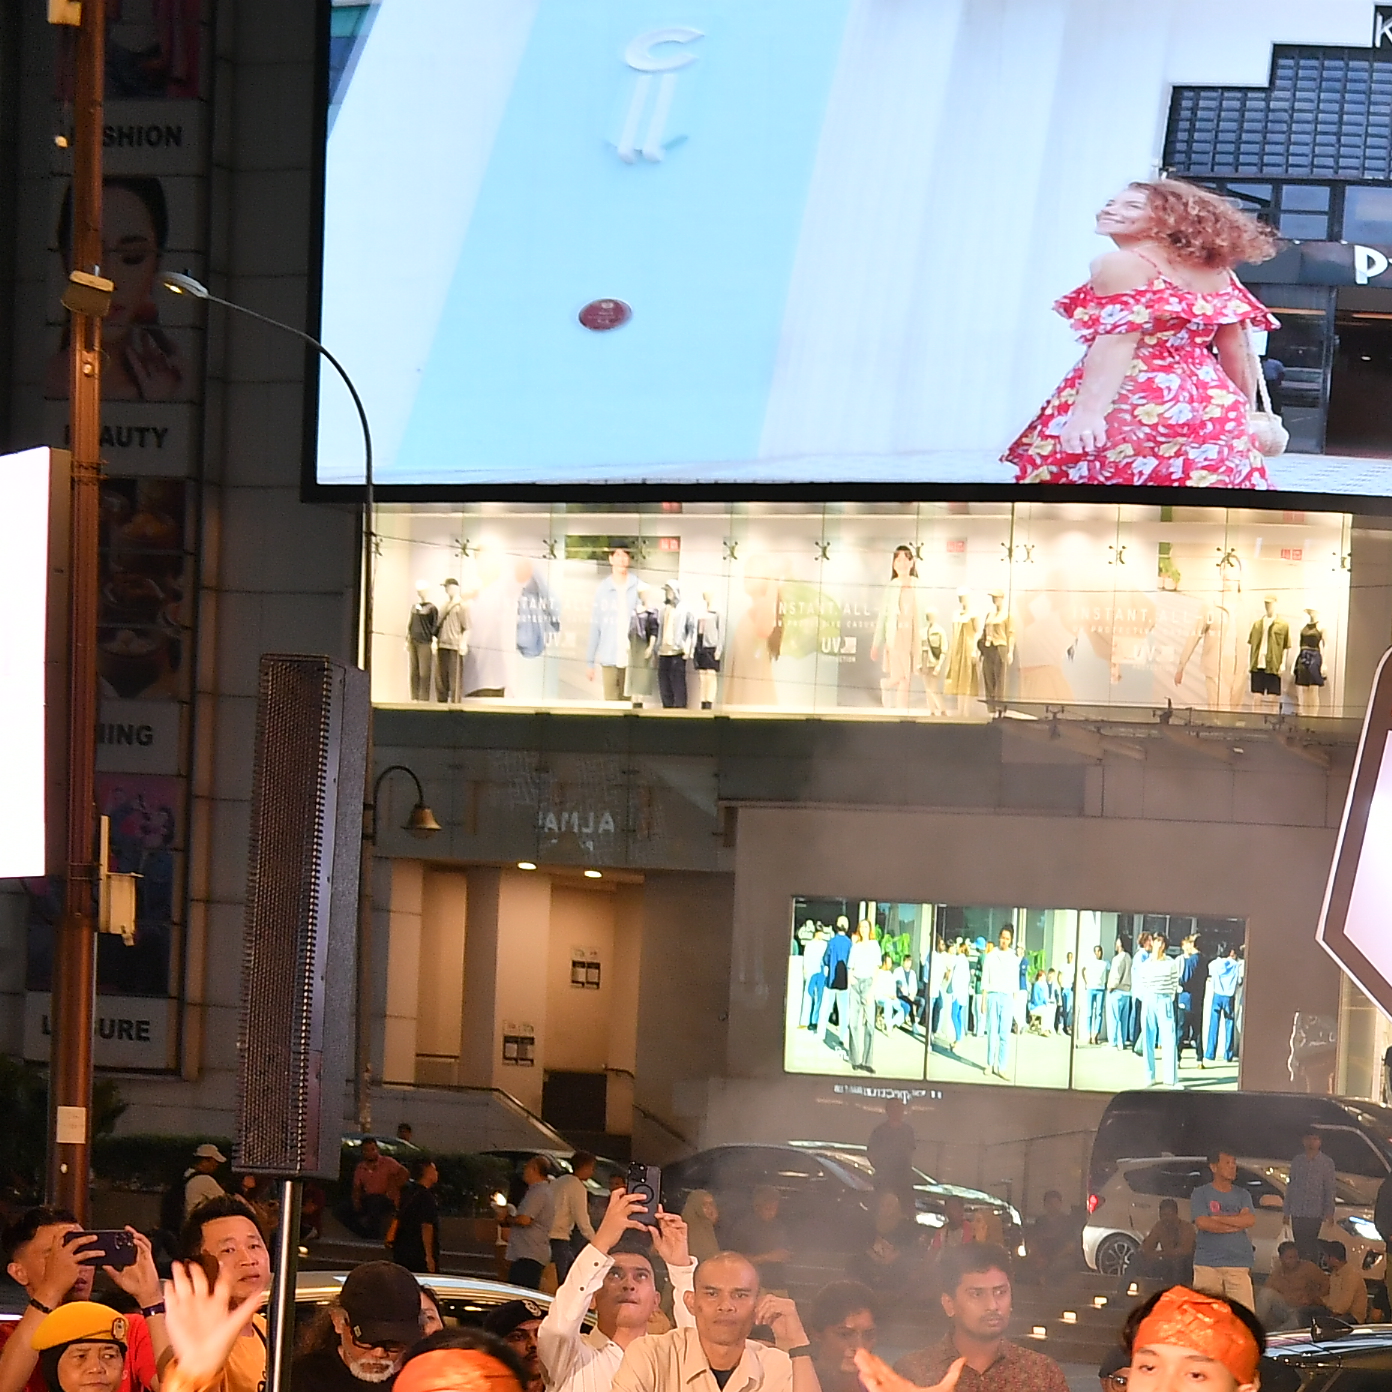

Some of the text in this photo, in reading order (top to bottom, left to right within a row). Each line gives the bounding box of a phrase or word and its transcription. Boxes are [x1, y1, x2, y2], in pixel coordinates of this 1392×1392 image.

[69, 125, 182, 148] SHION
[64, 424, 169, 449] AUTY
[98, 724, 154, 747] ING
[42, 1014, 151, 1043] LURE
